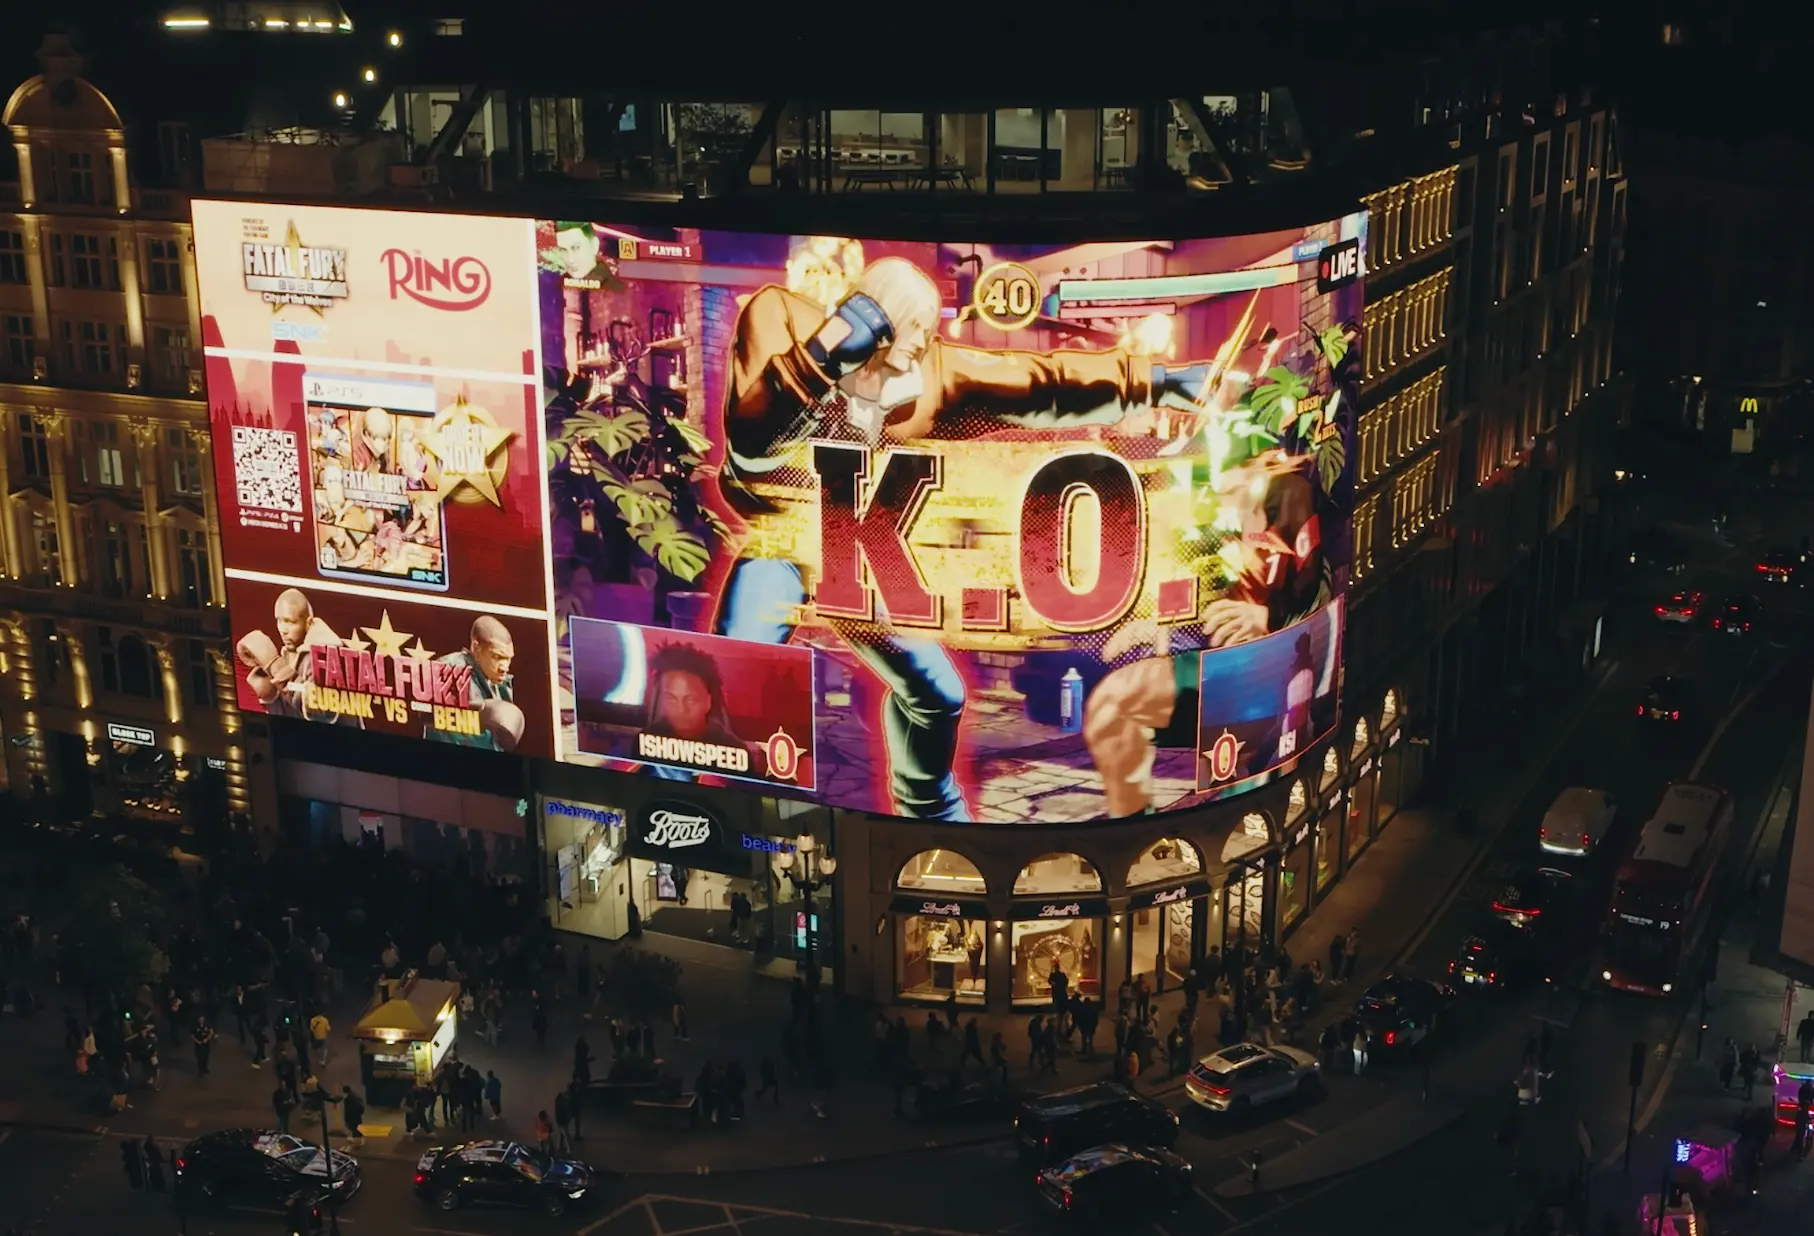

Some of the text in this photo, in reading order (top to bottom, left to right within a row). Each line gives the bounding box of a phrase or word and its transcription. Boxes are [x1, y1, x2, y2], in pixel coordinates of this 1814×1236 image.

[242, 243, 347, 282] FATAL FURY
[649, 245, 691, 258] PLAYER 1
[1330, 246, 1357, 282] LIVE
[379, 247, 491, 312] RING
[984, 278, 1034, 316] 40
[272, 322, 323, 341] SNK
[327, 385, 363, 399] PS5
[445, 446, 487, 473] NOW
[808, 439, 1200, 632] K.O.
[411, 569, 442, 583] SNK
[309, 644, 473, 708] FATAL FURY
[307, 683, 375, 719] EUBANK
[383, 696, 408, 724] VS
[433, 704, 480, 736] BENN
[638, 732, 749, 773] ISHOWSPEED
[546, 802, 622, 827] pharmacy
[643, 809, 711, 849] Boots
[1660, 920, 1670, 930] 19
